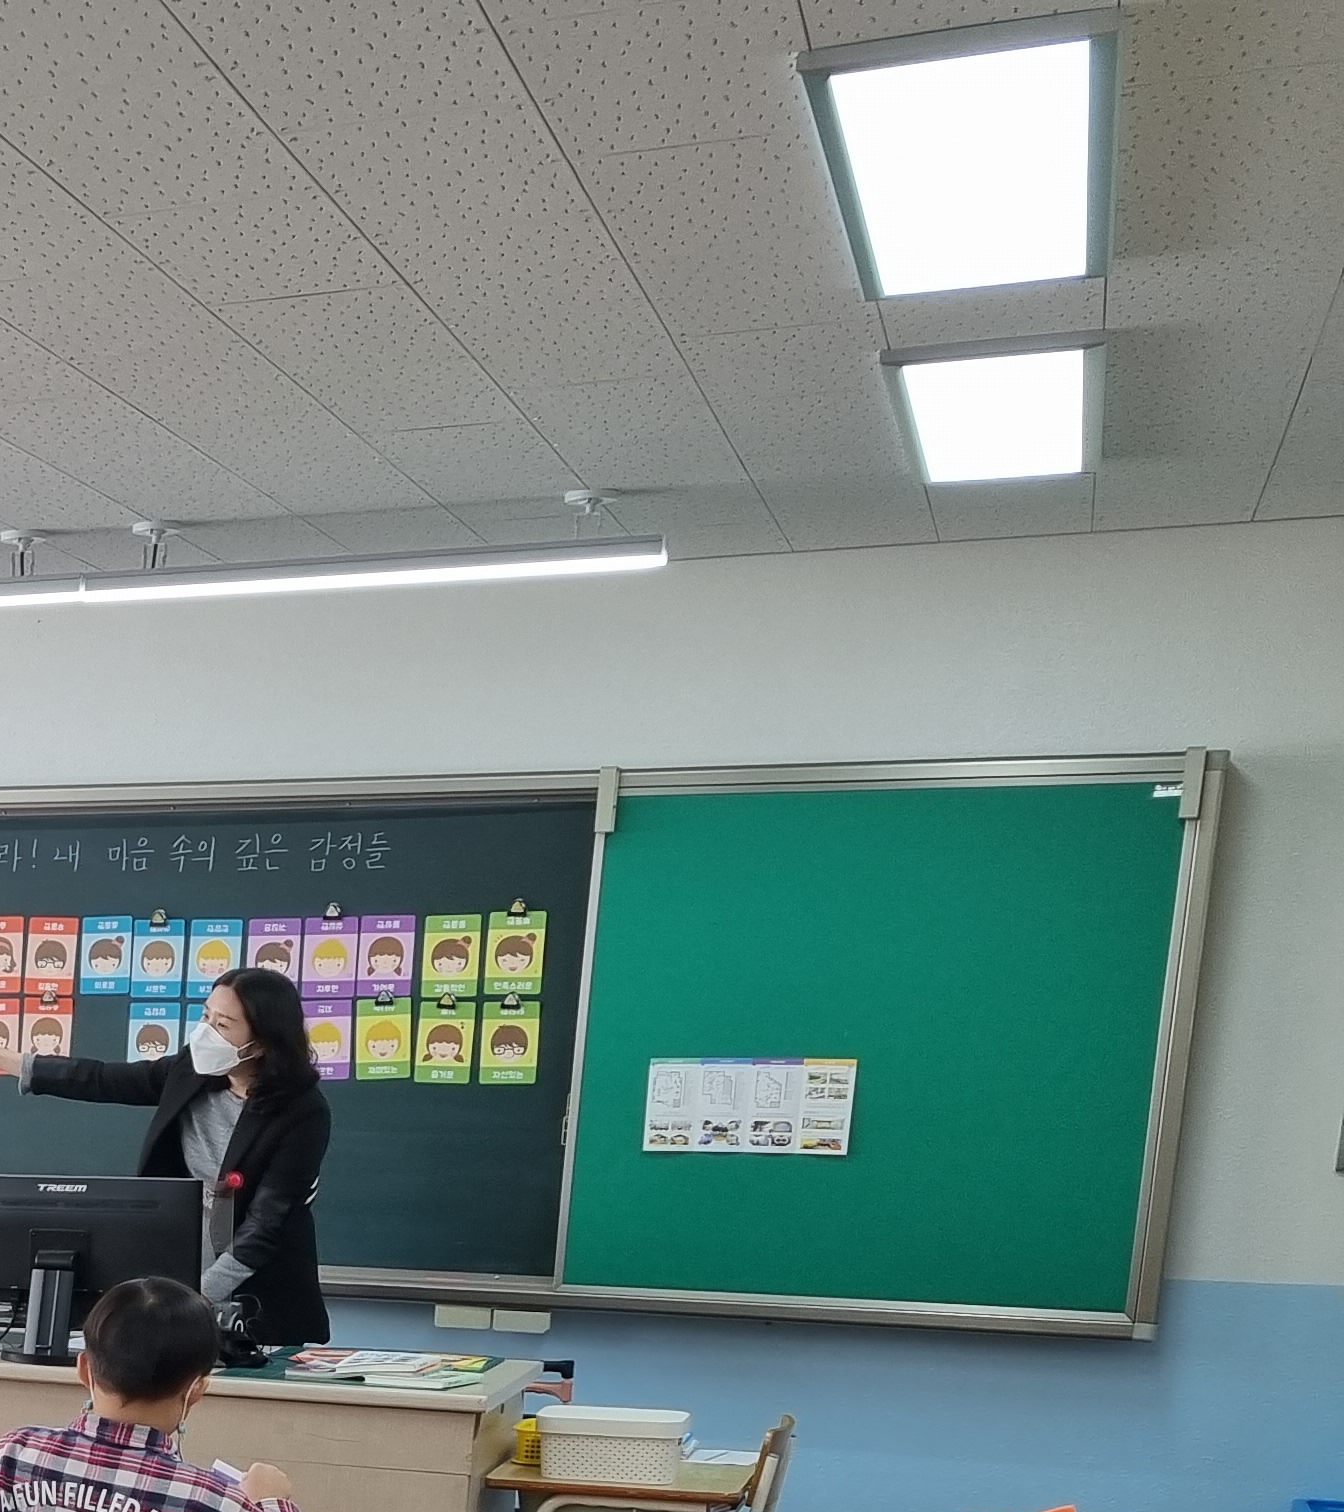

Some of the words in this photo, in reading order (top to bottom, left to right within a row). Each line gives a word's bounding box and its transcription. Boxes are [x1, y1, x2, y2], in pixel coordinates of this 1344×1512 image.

[53, 841, 81, 872] 내
[108, 836, 155, 872] 마음
[170, 834, 214, 873] 속의
[234, 833, 290, 873] 깊은
[309, 831, 392, 873] 감정들
[37, 1183, 88, 1193] TREEM
[12, 1481, 57, 1510] FUN
